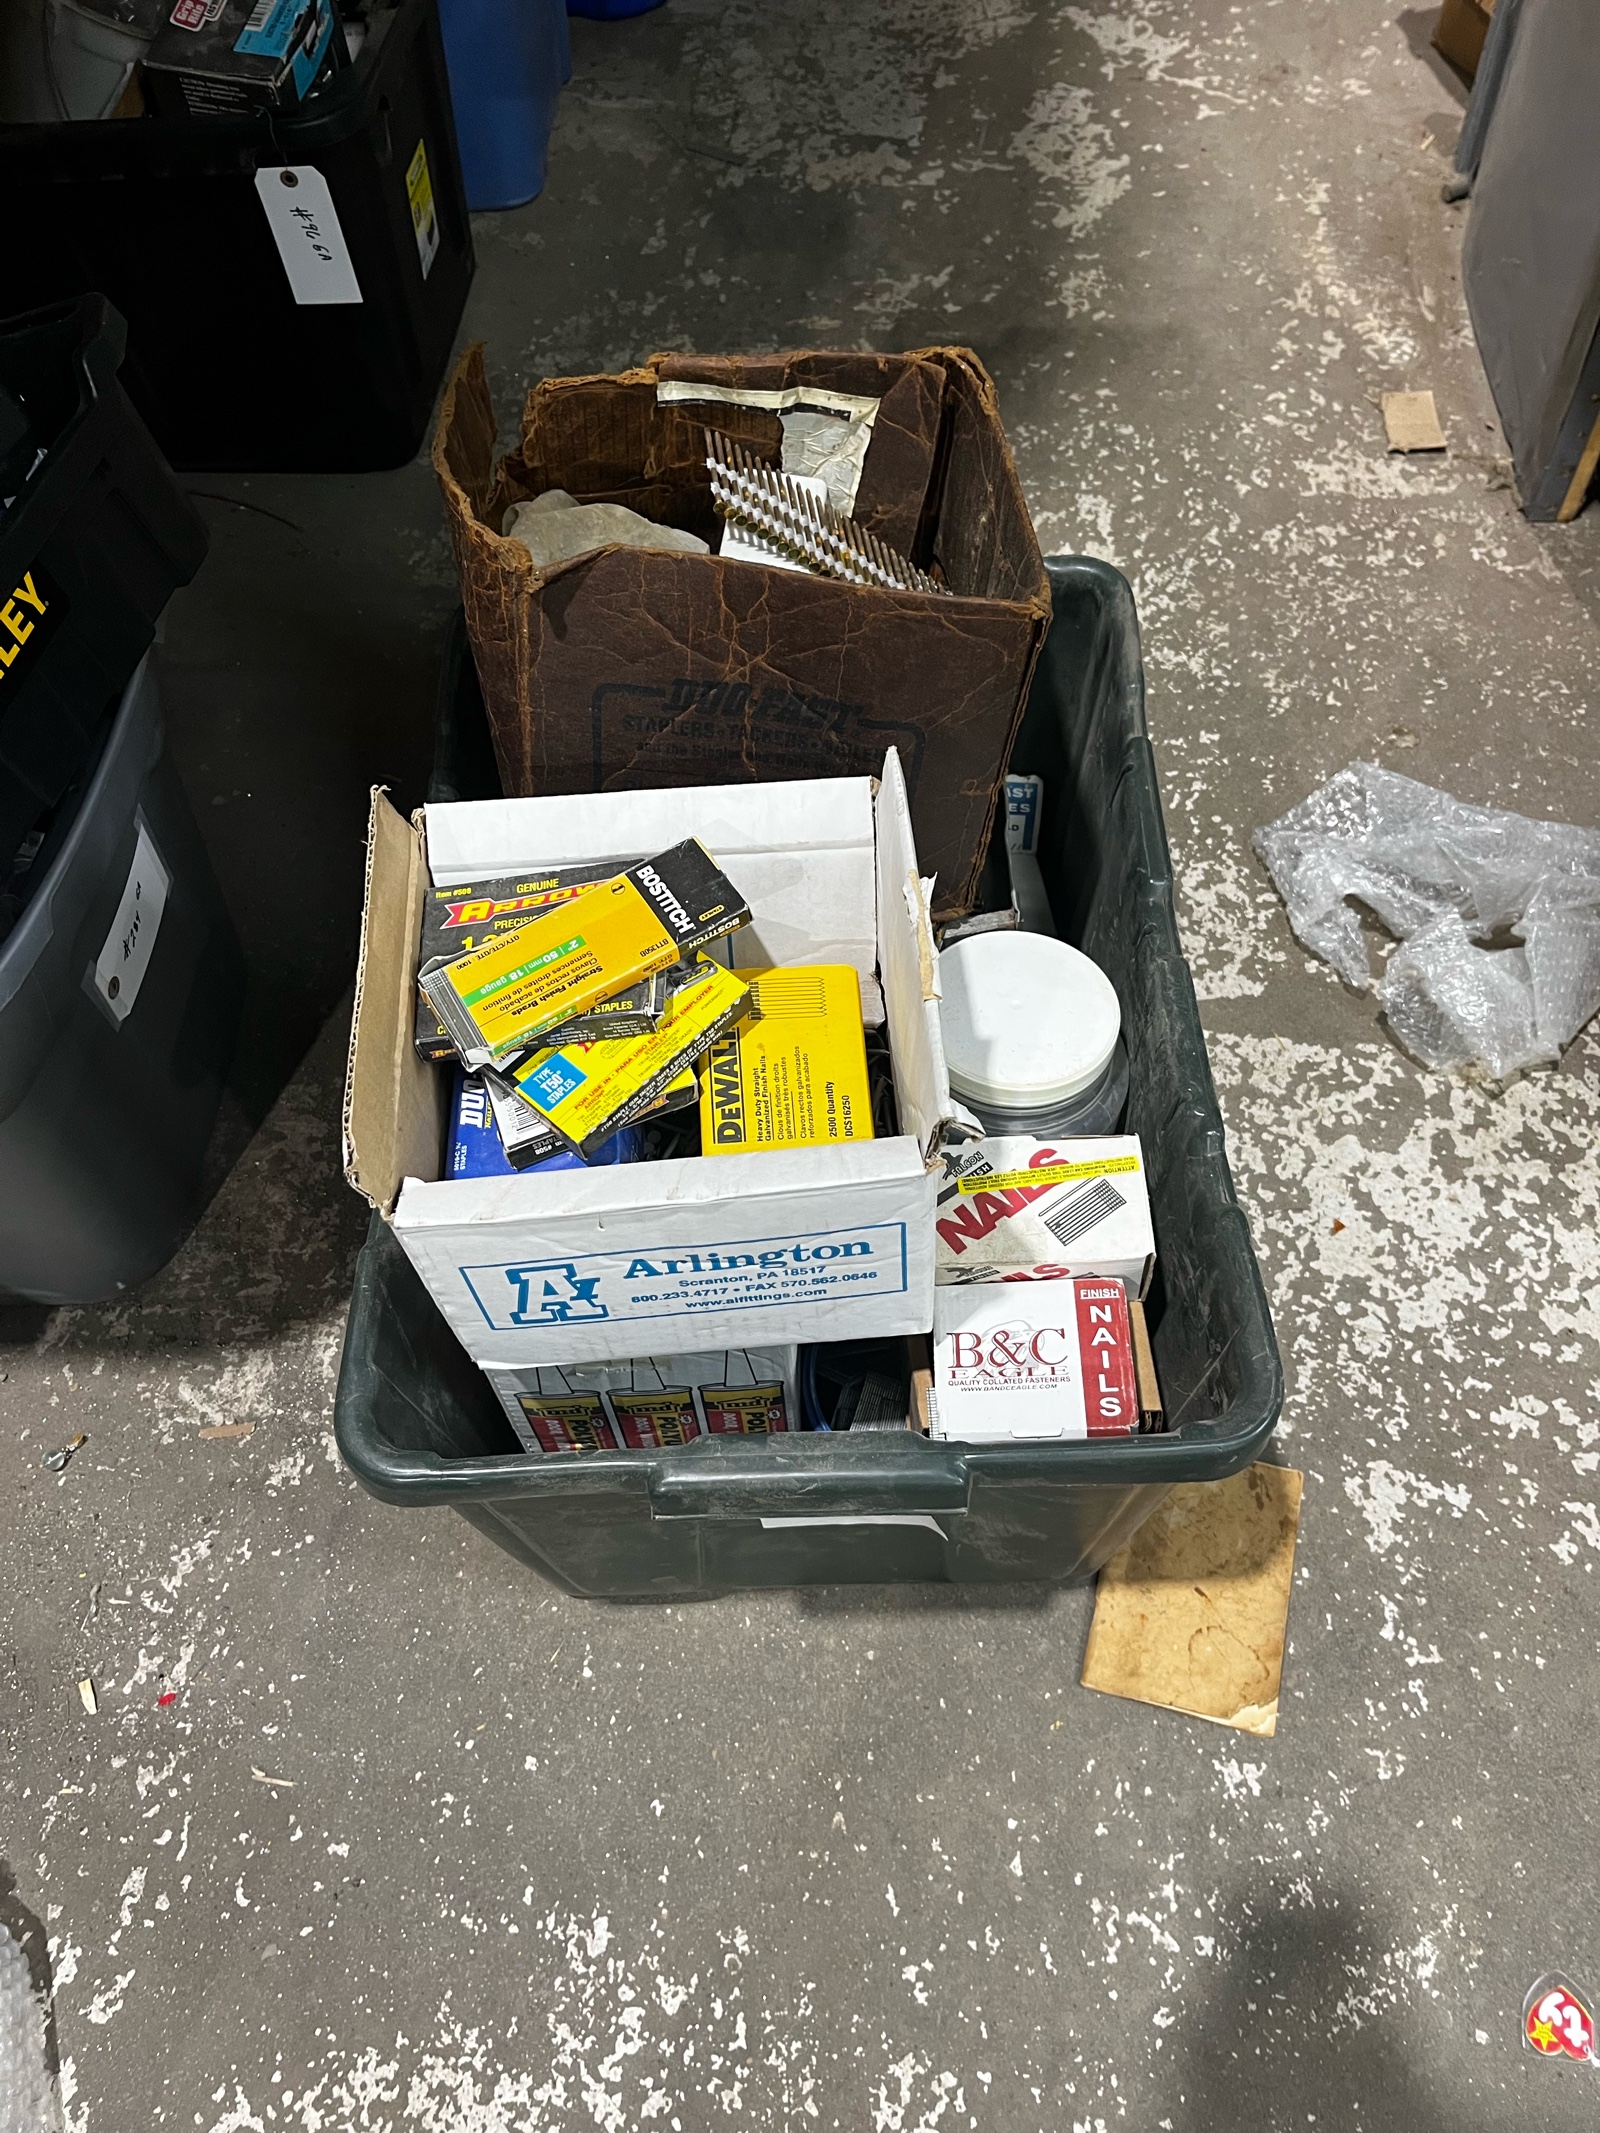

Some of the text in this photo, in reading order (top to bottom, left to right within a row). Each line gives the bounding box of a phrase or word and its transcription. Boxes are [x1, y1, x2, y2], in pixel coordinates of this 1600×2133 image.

[176, 0, 194, 20] Grip
[188, 4, 204, 24] Rite
[0, 571, 46, 680] LEY
[516, 878, 559, 894] GENUINE
[636, 865, 694, 934] BOSTITCH
[689, 916, 740, 950] BOSTITCH
[509, 970, 523, 980] 18
[552, 951, 592, 974] Semences
[480, 976, 507, 994] gauge
[500, 958, 597, 1011] Clavos rectos de acabado
[512, 966, 602, 1015] Straight Finish Brads
[524, 973, 550, 989] droites
[483, 994, 511, 1010] finition
[594, 1000, 633, 1013] STAPLES
[574, 1097, 588, 1109] FOR
[589, 1083, 602, 1096] USE
[602, 1076, 610, 1084] IN
[615, 1056, 632, 1073] PARA
[633, 1043, 648, 1057] USO
[647, 1034, 657, 1044] EN
[663, 1014, 679, 1031] POUR
[680, 985, 713, 1015] EMPLOYER
[533, 1066, 554, 1085] TYPE
[611, 1106, 628, 1121] STAPLE
[628, 1096, 639, 1106] GUN
[638, 1080, 655, 1096] TACKER
[655, 1068, 670, 1081] TAKES
[685, 1046, 693, 1054] OF
[694, 1036, 704, 1047] TYPE
[705, 1027, 714, 1036] T50
[780, 1057, 788, 1086] robustes
[794, 1046, 803, 1089] galvanizados
[802, 1053, 810, 1082] acabado
[548, 1076, 577, 1104] STAPLES
[712, 1031, 741, 1142] DEWALT
[763, 1100, 771, 1140] Galvanized
[776, 1109, 782, 1117] de
[784, 1103, 793, 1139] galvanisés
[825, 1081, 838, 1137] 2500 Quantity
[841, 1094, 854, 1137] DCS16250
[531, 1136, 558, 1149] TAPLES
[458, 1145, 467, 1169] STAPLES
[951, 1151, 984, 1178] FALCON
[623, 1241, 874, 1279] Arlington
[631, 1271, 877, 1303] 800.233.4717 FAX 570.562.0646
[678, 1266, 825, 1288] Scranton, PA 18517
[1080, 1288, 1120, 1298] FINISH
[946, 1328, 1068, 1369] B&C
[1089, 1305, 1121, 1417] NAILS
[952, 1366, 1065, 1378] EAGLE
[961, 1384, 1057, 1392] WWW.BANDCEAGLE.COM
